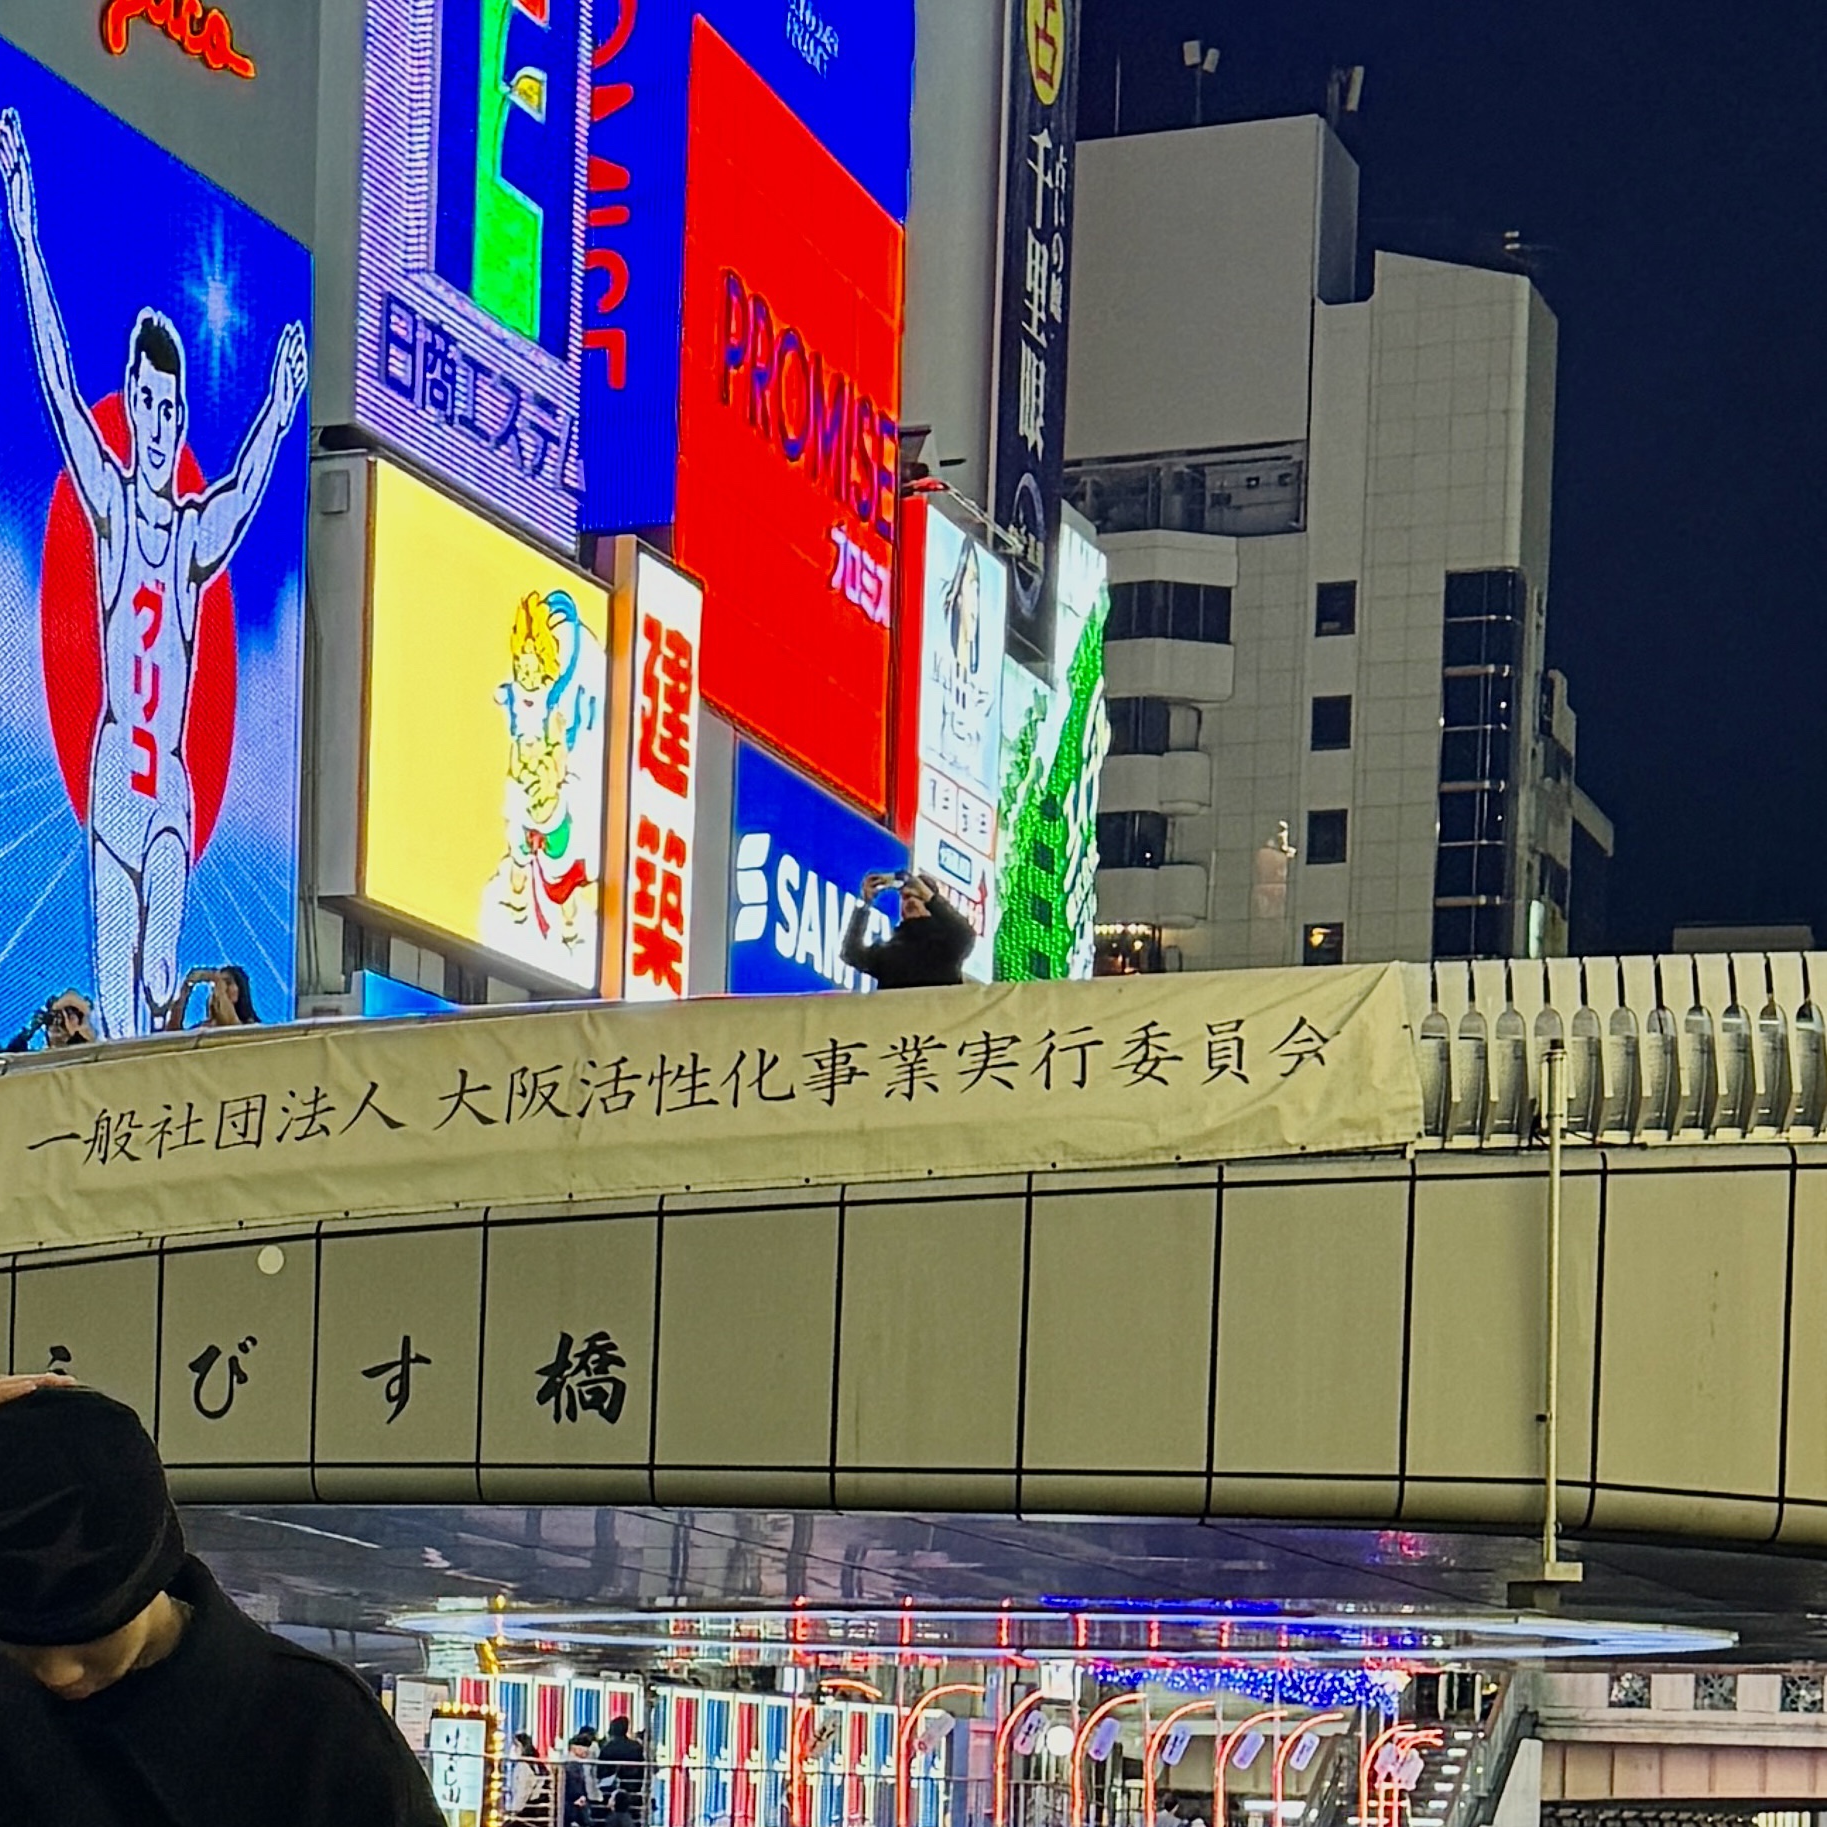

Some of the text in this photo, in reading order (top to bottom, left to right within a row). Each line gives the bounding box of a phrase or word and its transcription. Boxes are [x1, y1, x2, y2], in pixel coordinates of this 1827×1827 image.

[721, 268, 896, 544] PROMISE
[131, 579, 166, 800] グリコ
[27, 1080, 403, 1166] 一般社団法人
[432, 1014, 1343, 1131] 大阪活性化事業実行委員会
[48, 1330, 627, 1426] びす橋
